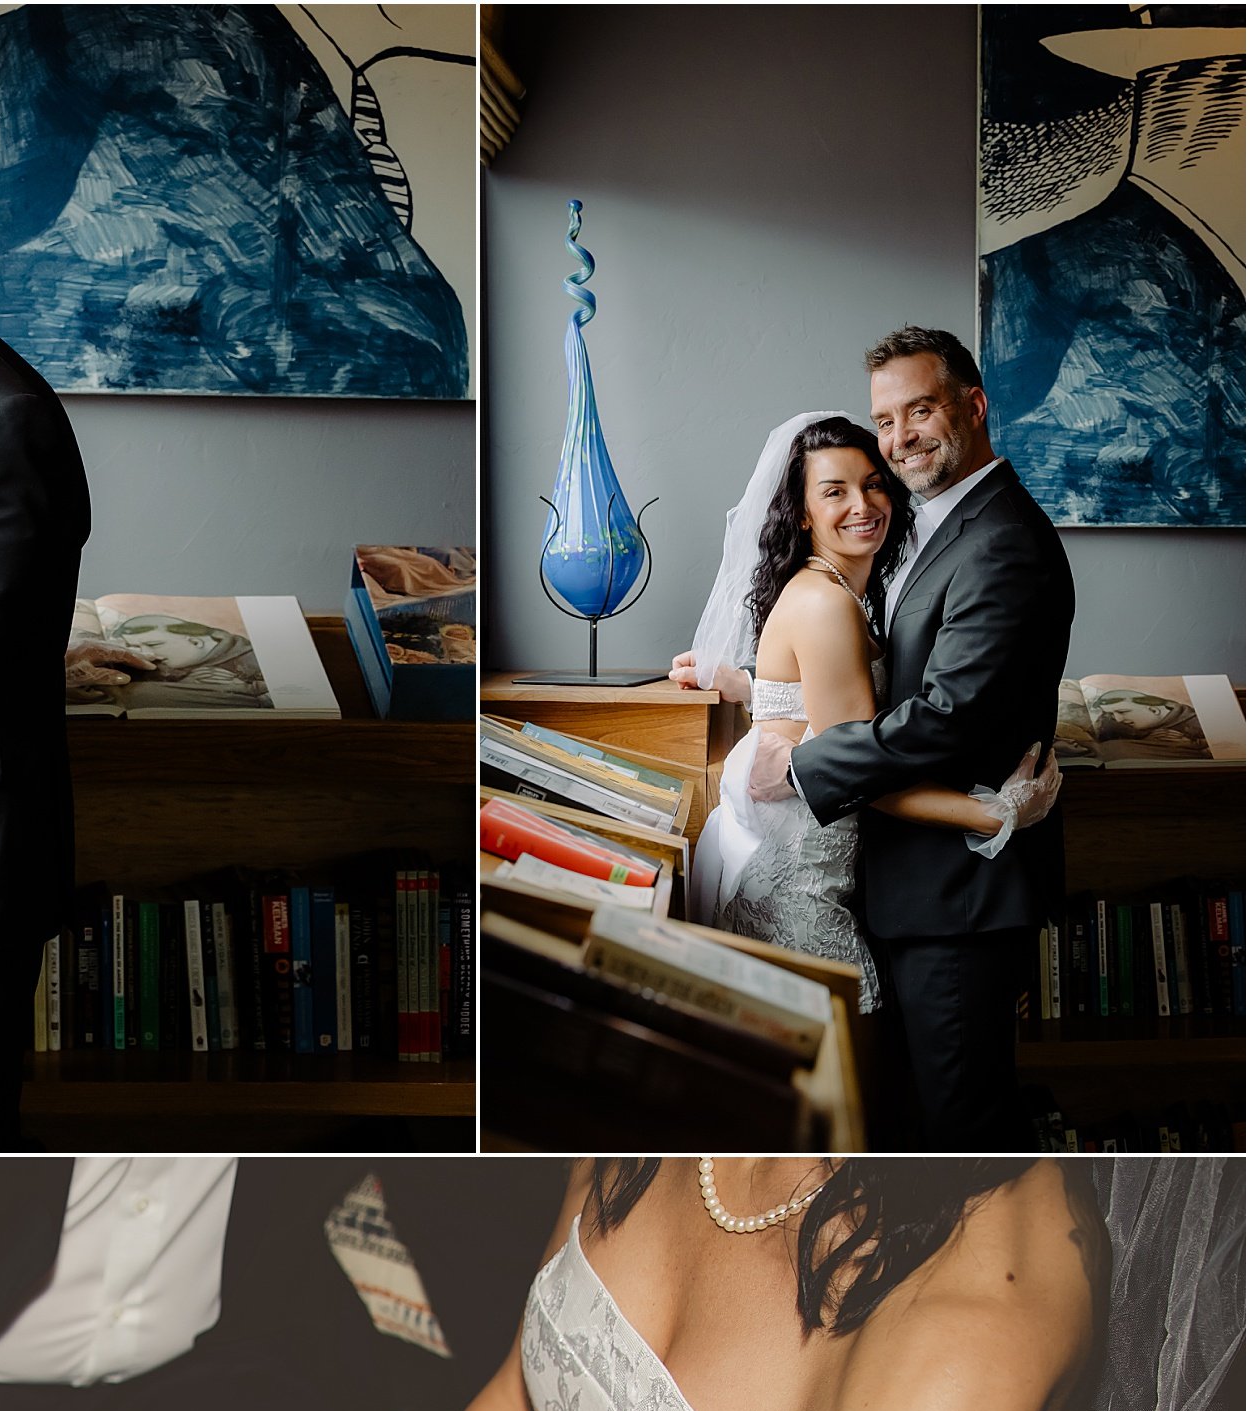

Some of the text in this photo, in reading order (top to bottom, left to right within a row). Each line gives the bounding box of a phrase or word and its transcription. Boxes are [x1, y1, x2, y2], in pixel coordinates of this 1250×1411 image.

[272, 901, 282, 945] KELMAN
[280, 900, 288, 929] JAMES
[460, 908, 470, 961] SOMETHING
[216, 911, 226, 971] GORE VIDAL
[460, 1001, 470, 1035] HIDDEN
